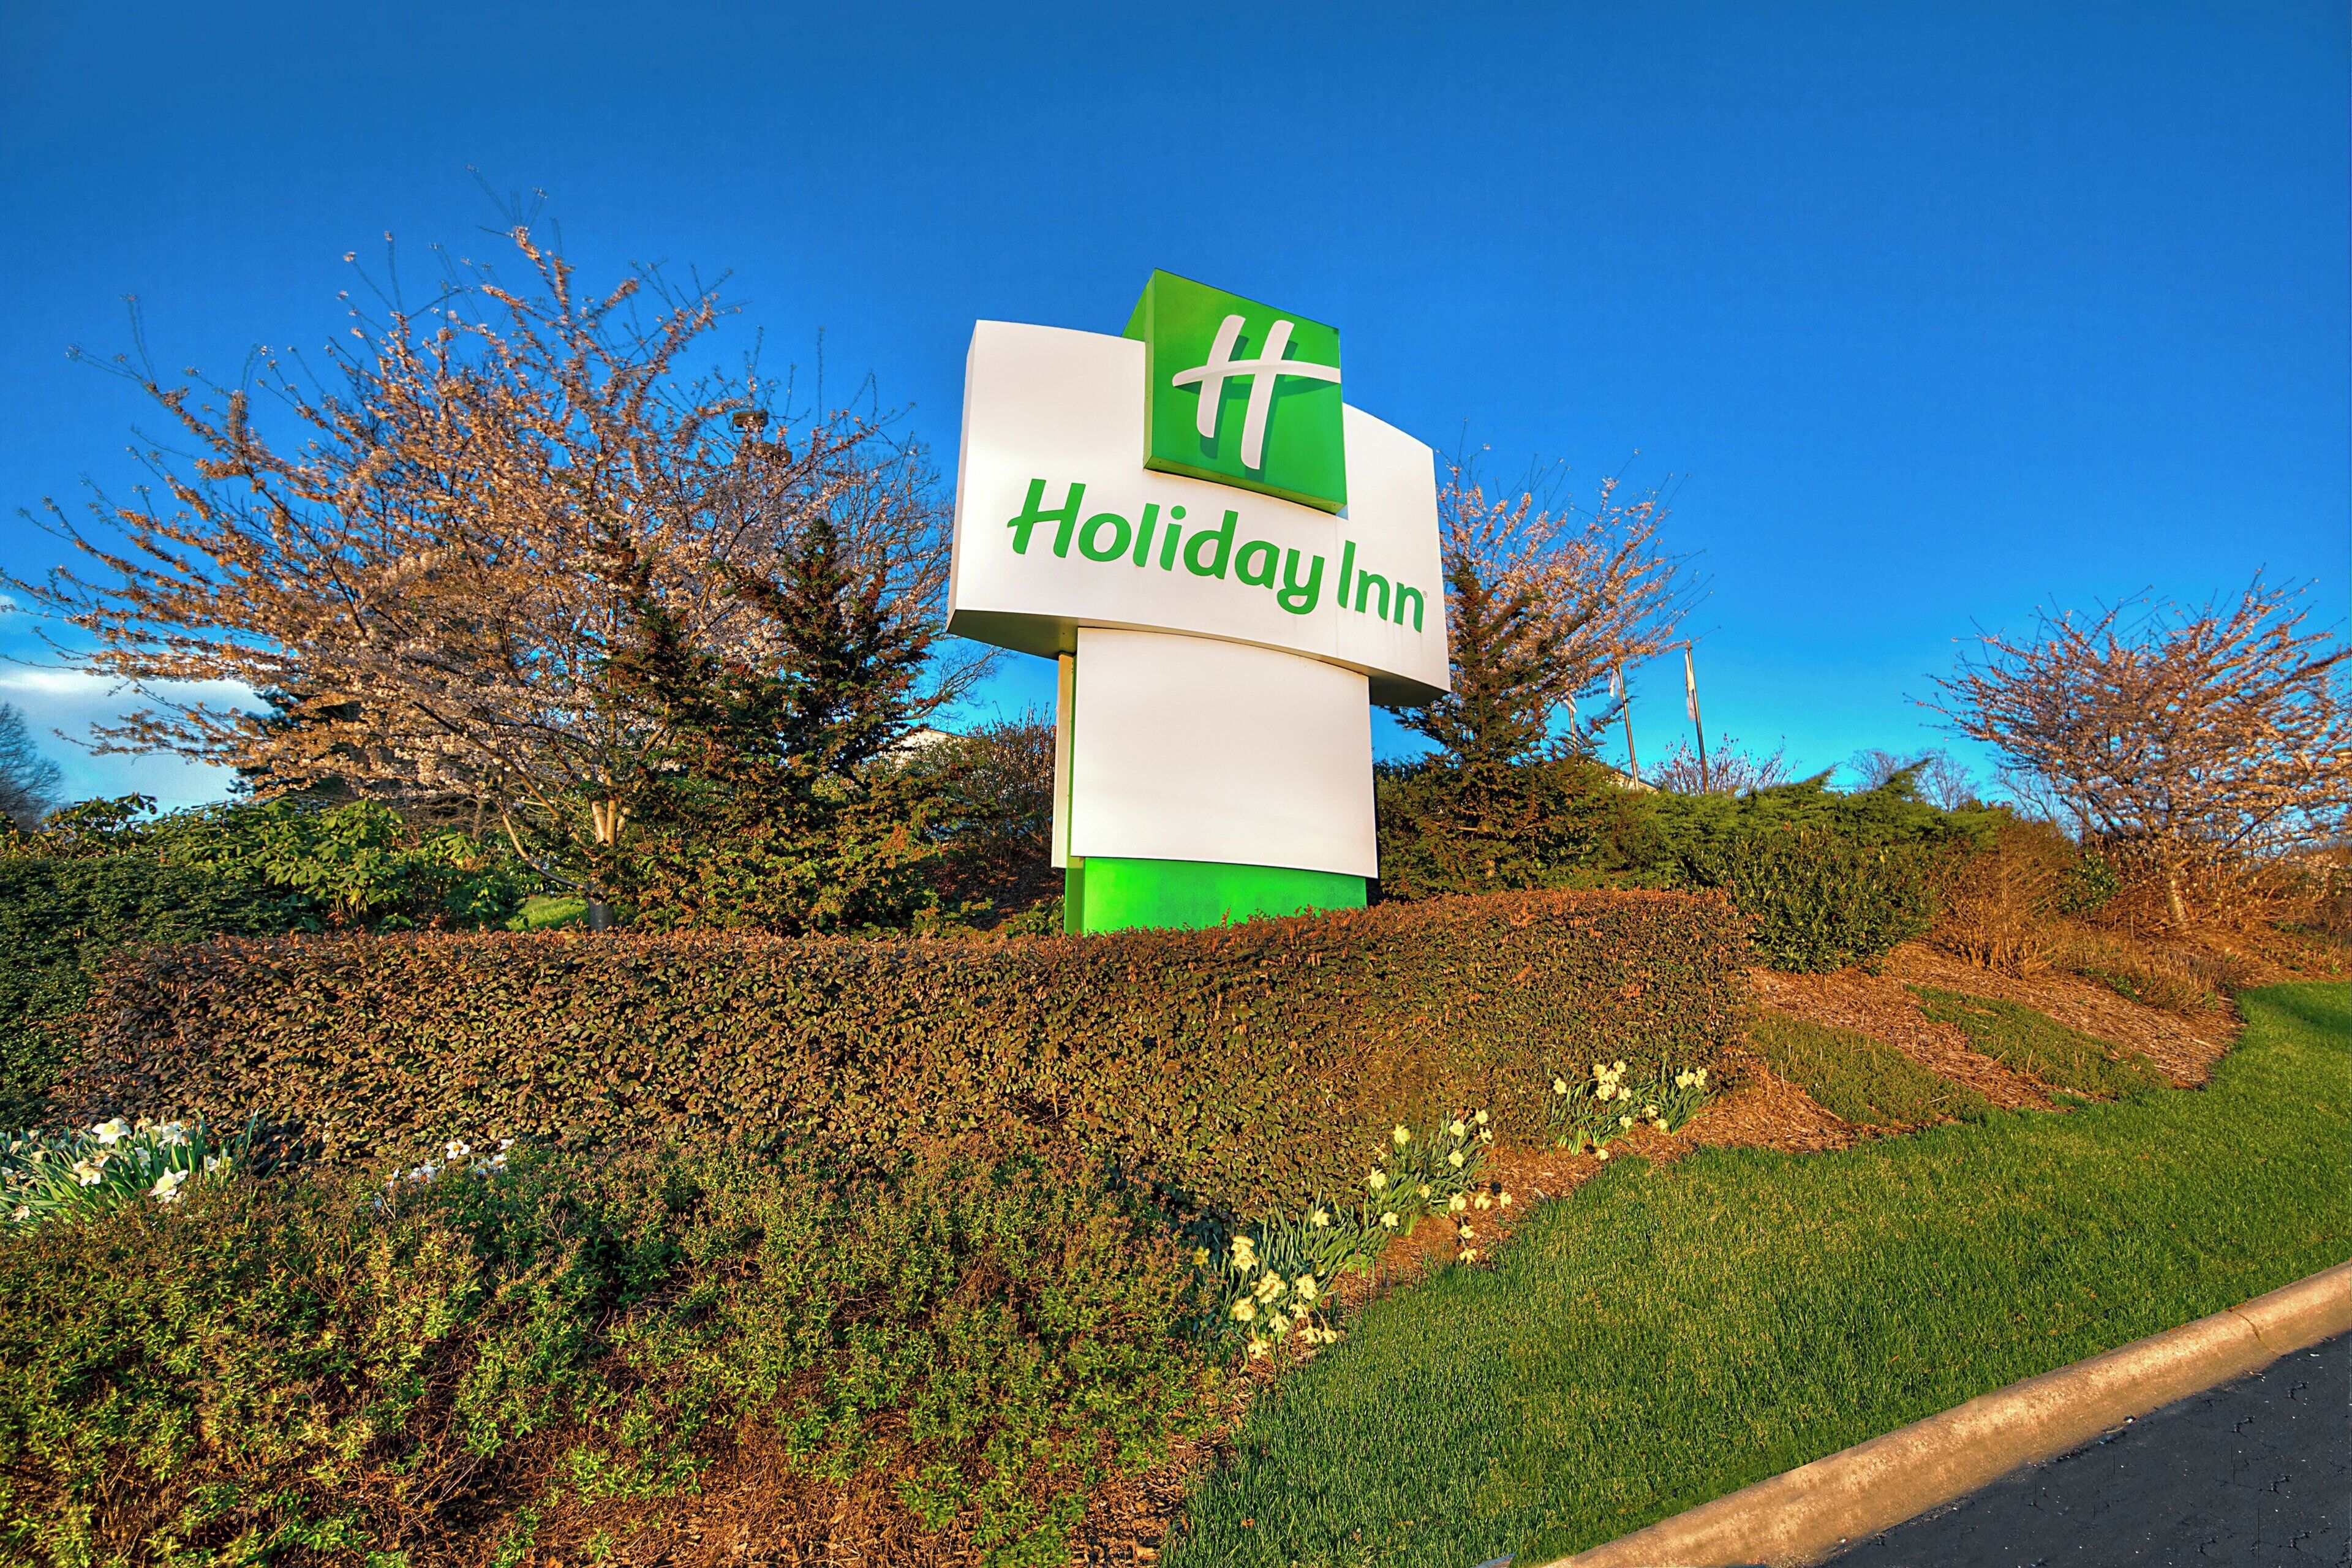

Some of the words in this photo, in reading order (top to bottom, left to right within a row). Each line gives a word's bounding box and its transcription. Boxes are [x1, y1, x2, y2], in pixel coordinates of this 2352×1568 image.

[1172, 314, 1341, 470] H
[1006, 478, 1325, 615] Holiday
[1337, 540, 1424, 633] Inn
